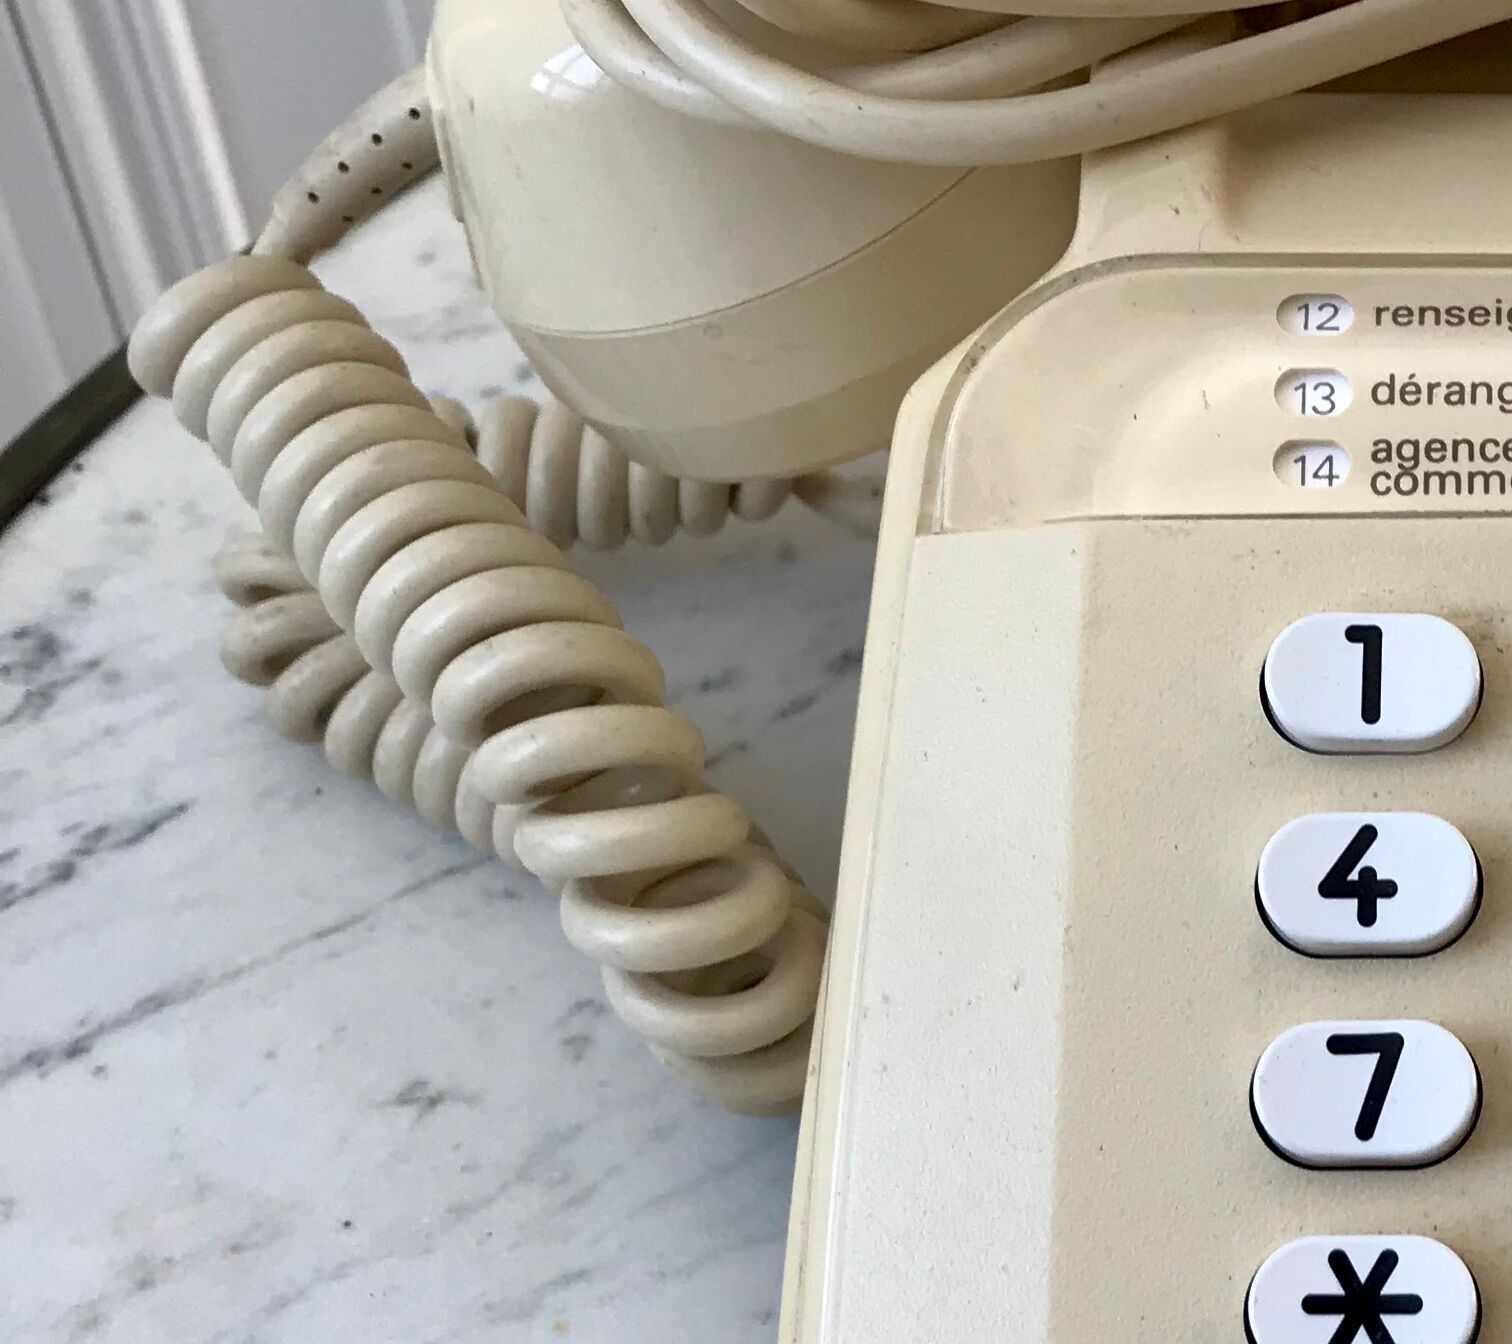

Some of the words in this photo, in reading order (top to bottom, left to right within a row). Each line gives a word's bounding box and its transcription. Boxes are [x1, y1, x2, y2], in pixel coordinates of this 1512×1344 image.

[1296, 302, 1341, 331] 12
[1293, 382, 1337, 416] 13
[1293, 454, 1340, 488] 14
[1344, 624, 1383, 725] 1
[1317, 824, 1399, 928] 4
[1325, 1032, 1405, 1142] 7
